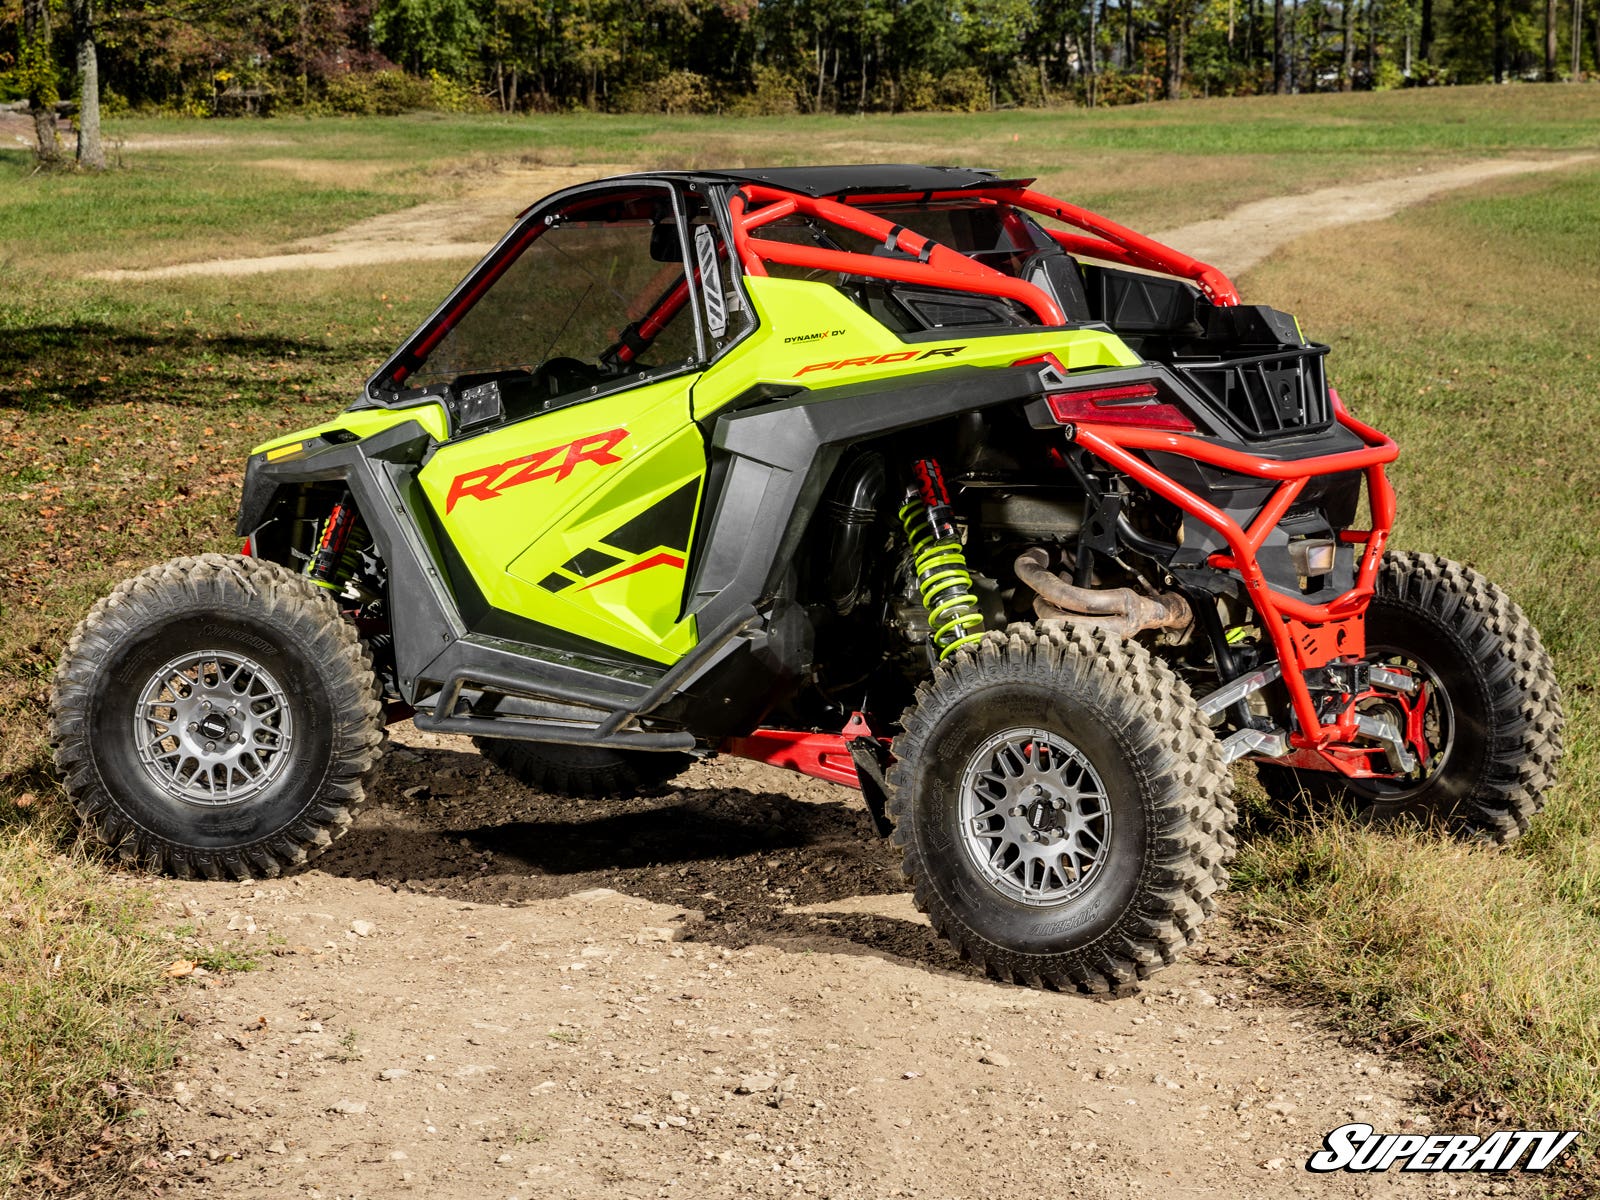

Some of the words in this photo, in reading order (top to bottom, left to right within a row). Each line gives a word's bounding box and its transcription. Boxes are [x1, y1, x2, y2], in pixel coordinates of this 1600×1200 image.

[784, 330, 829, 344] DYNAMIX
[831, 329, 847, 337] DV
[792, 350, 922, 378] PRO
[915, 345, 968, 361] R
[446, 427, 631, 517] RZR
